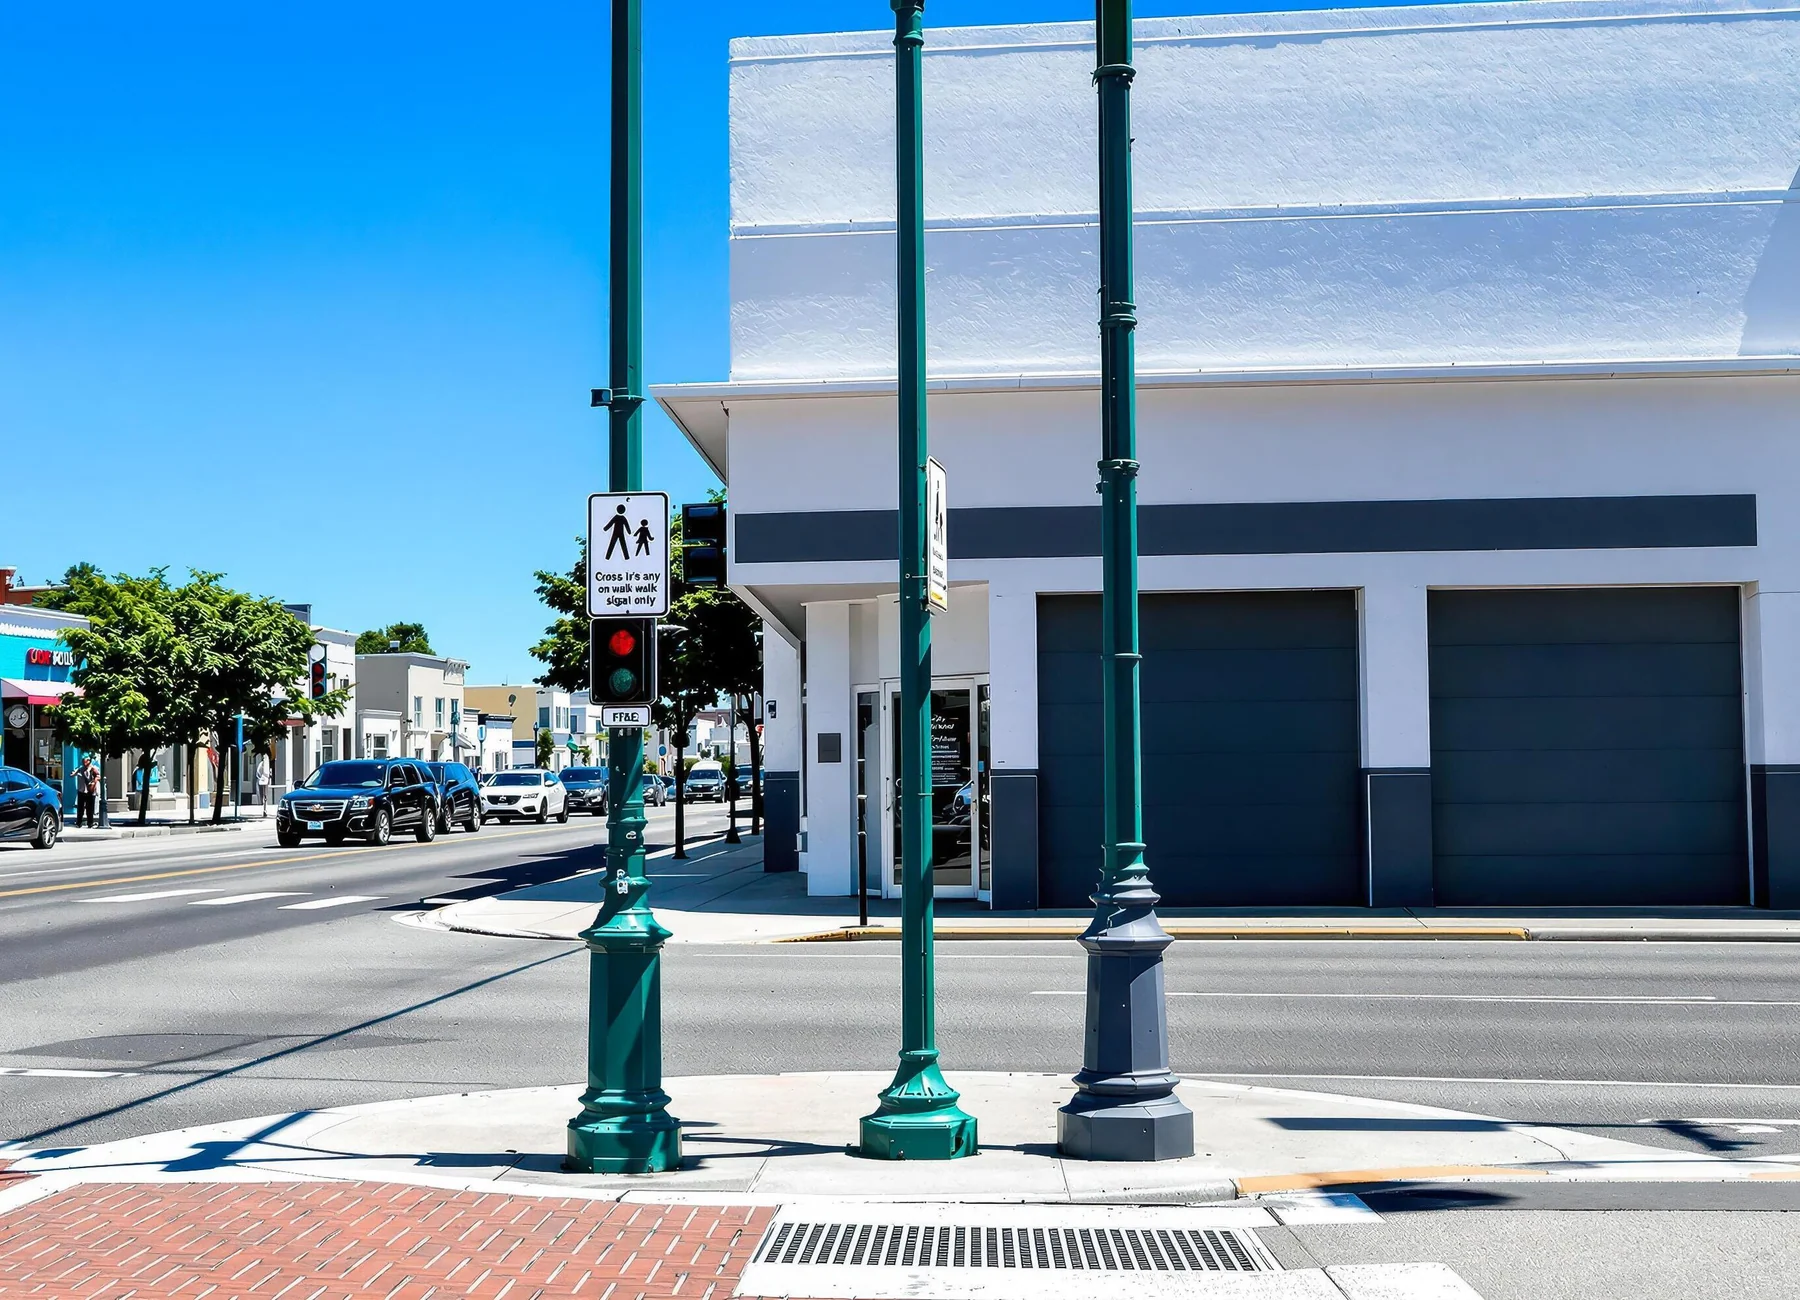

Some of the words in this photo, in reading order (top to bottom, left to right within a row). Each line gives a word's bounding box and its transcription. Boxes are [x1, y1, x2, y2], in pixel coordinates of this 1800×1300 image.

[595, 571, 623, 582] Cross
[643, 572, 661, 584] any
[598, 586, 610, 594] on
[635, 582, 658, 593] walk
[634, 594, 656, 607] only
